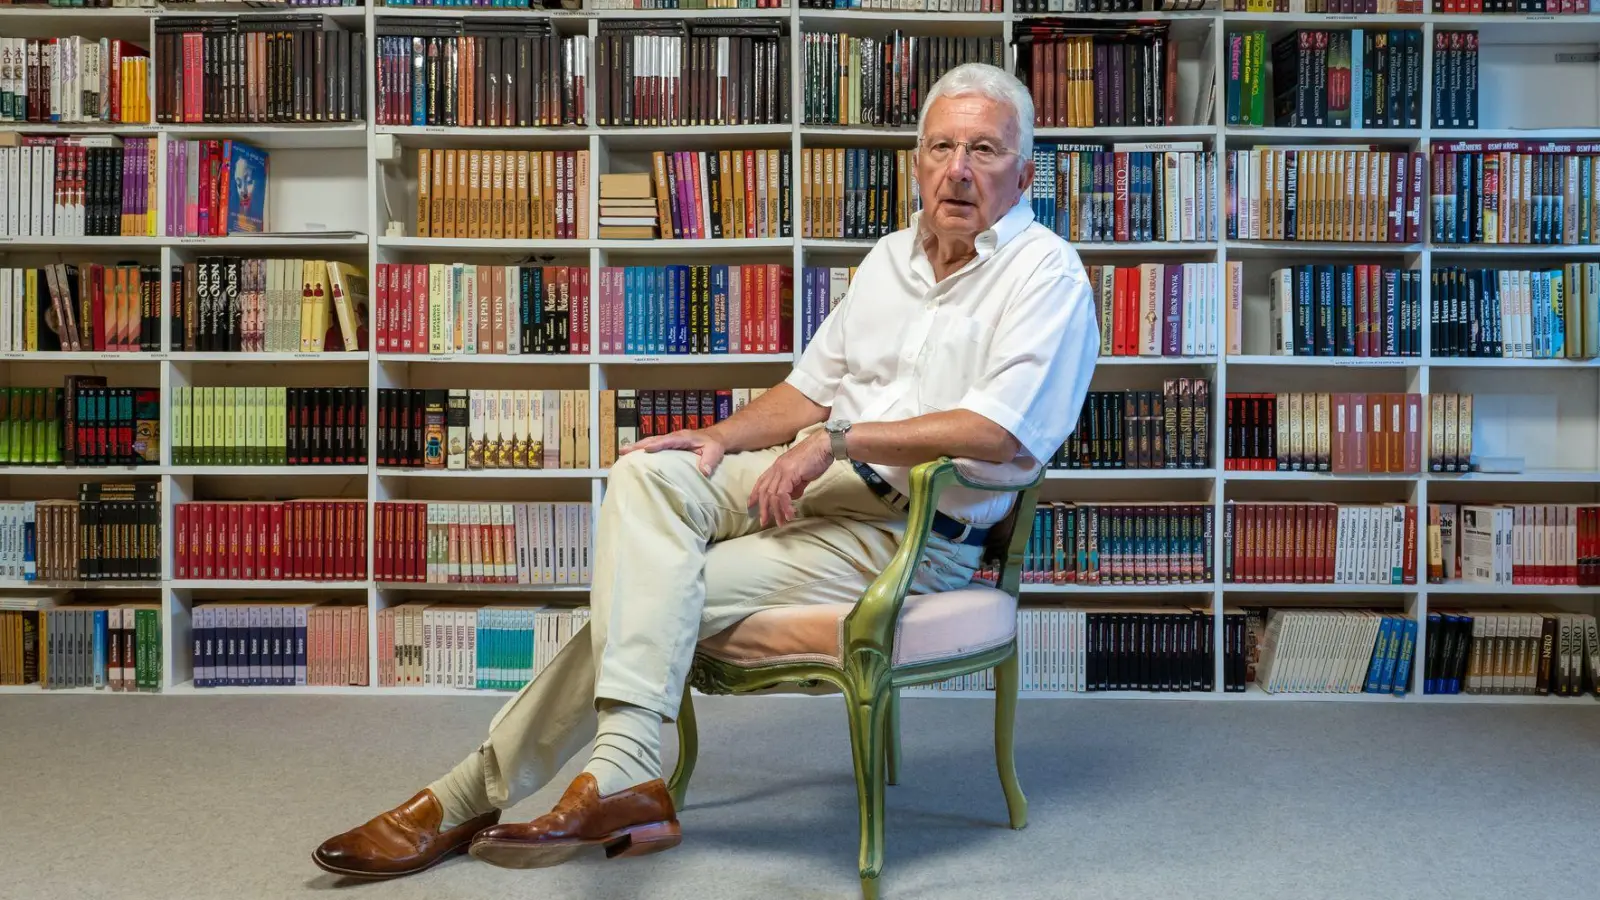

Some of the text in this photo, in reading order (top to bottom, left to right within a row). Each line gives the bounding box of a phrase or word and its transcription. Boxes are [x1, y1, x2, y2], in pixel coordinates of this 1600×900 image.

[1057, 144, 1104, 152] NEFERTITI
[1048, 153, 1056, 198] NEFERTITI
[1117, 169, 1127, 200] NERO
[197, 264, 208, 298] NERO
[210, 264, 220, 298] NERO
[227, 264, 238, 298] NERO
[480, 296, 488, 330] ΝΕΡΩΝ
[1165, 407, 1177, 432] SÜNDE
[1180, 407, 1192, 432] SÜNDE
[1194, 407, 1206, 432] SÜNDE
[1056, 536, 1064, 550] Die
[1542, 635, 1552, 658] NERO
[1561, 626, 1570, 655] NERO
[1572, 626, 1582, 654] NERO
[1587, 626, 1598, 656] NERO
